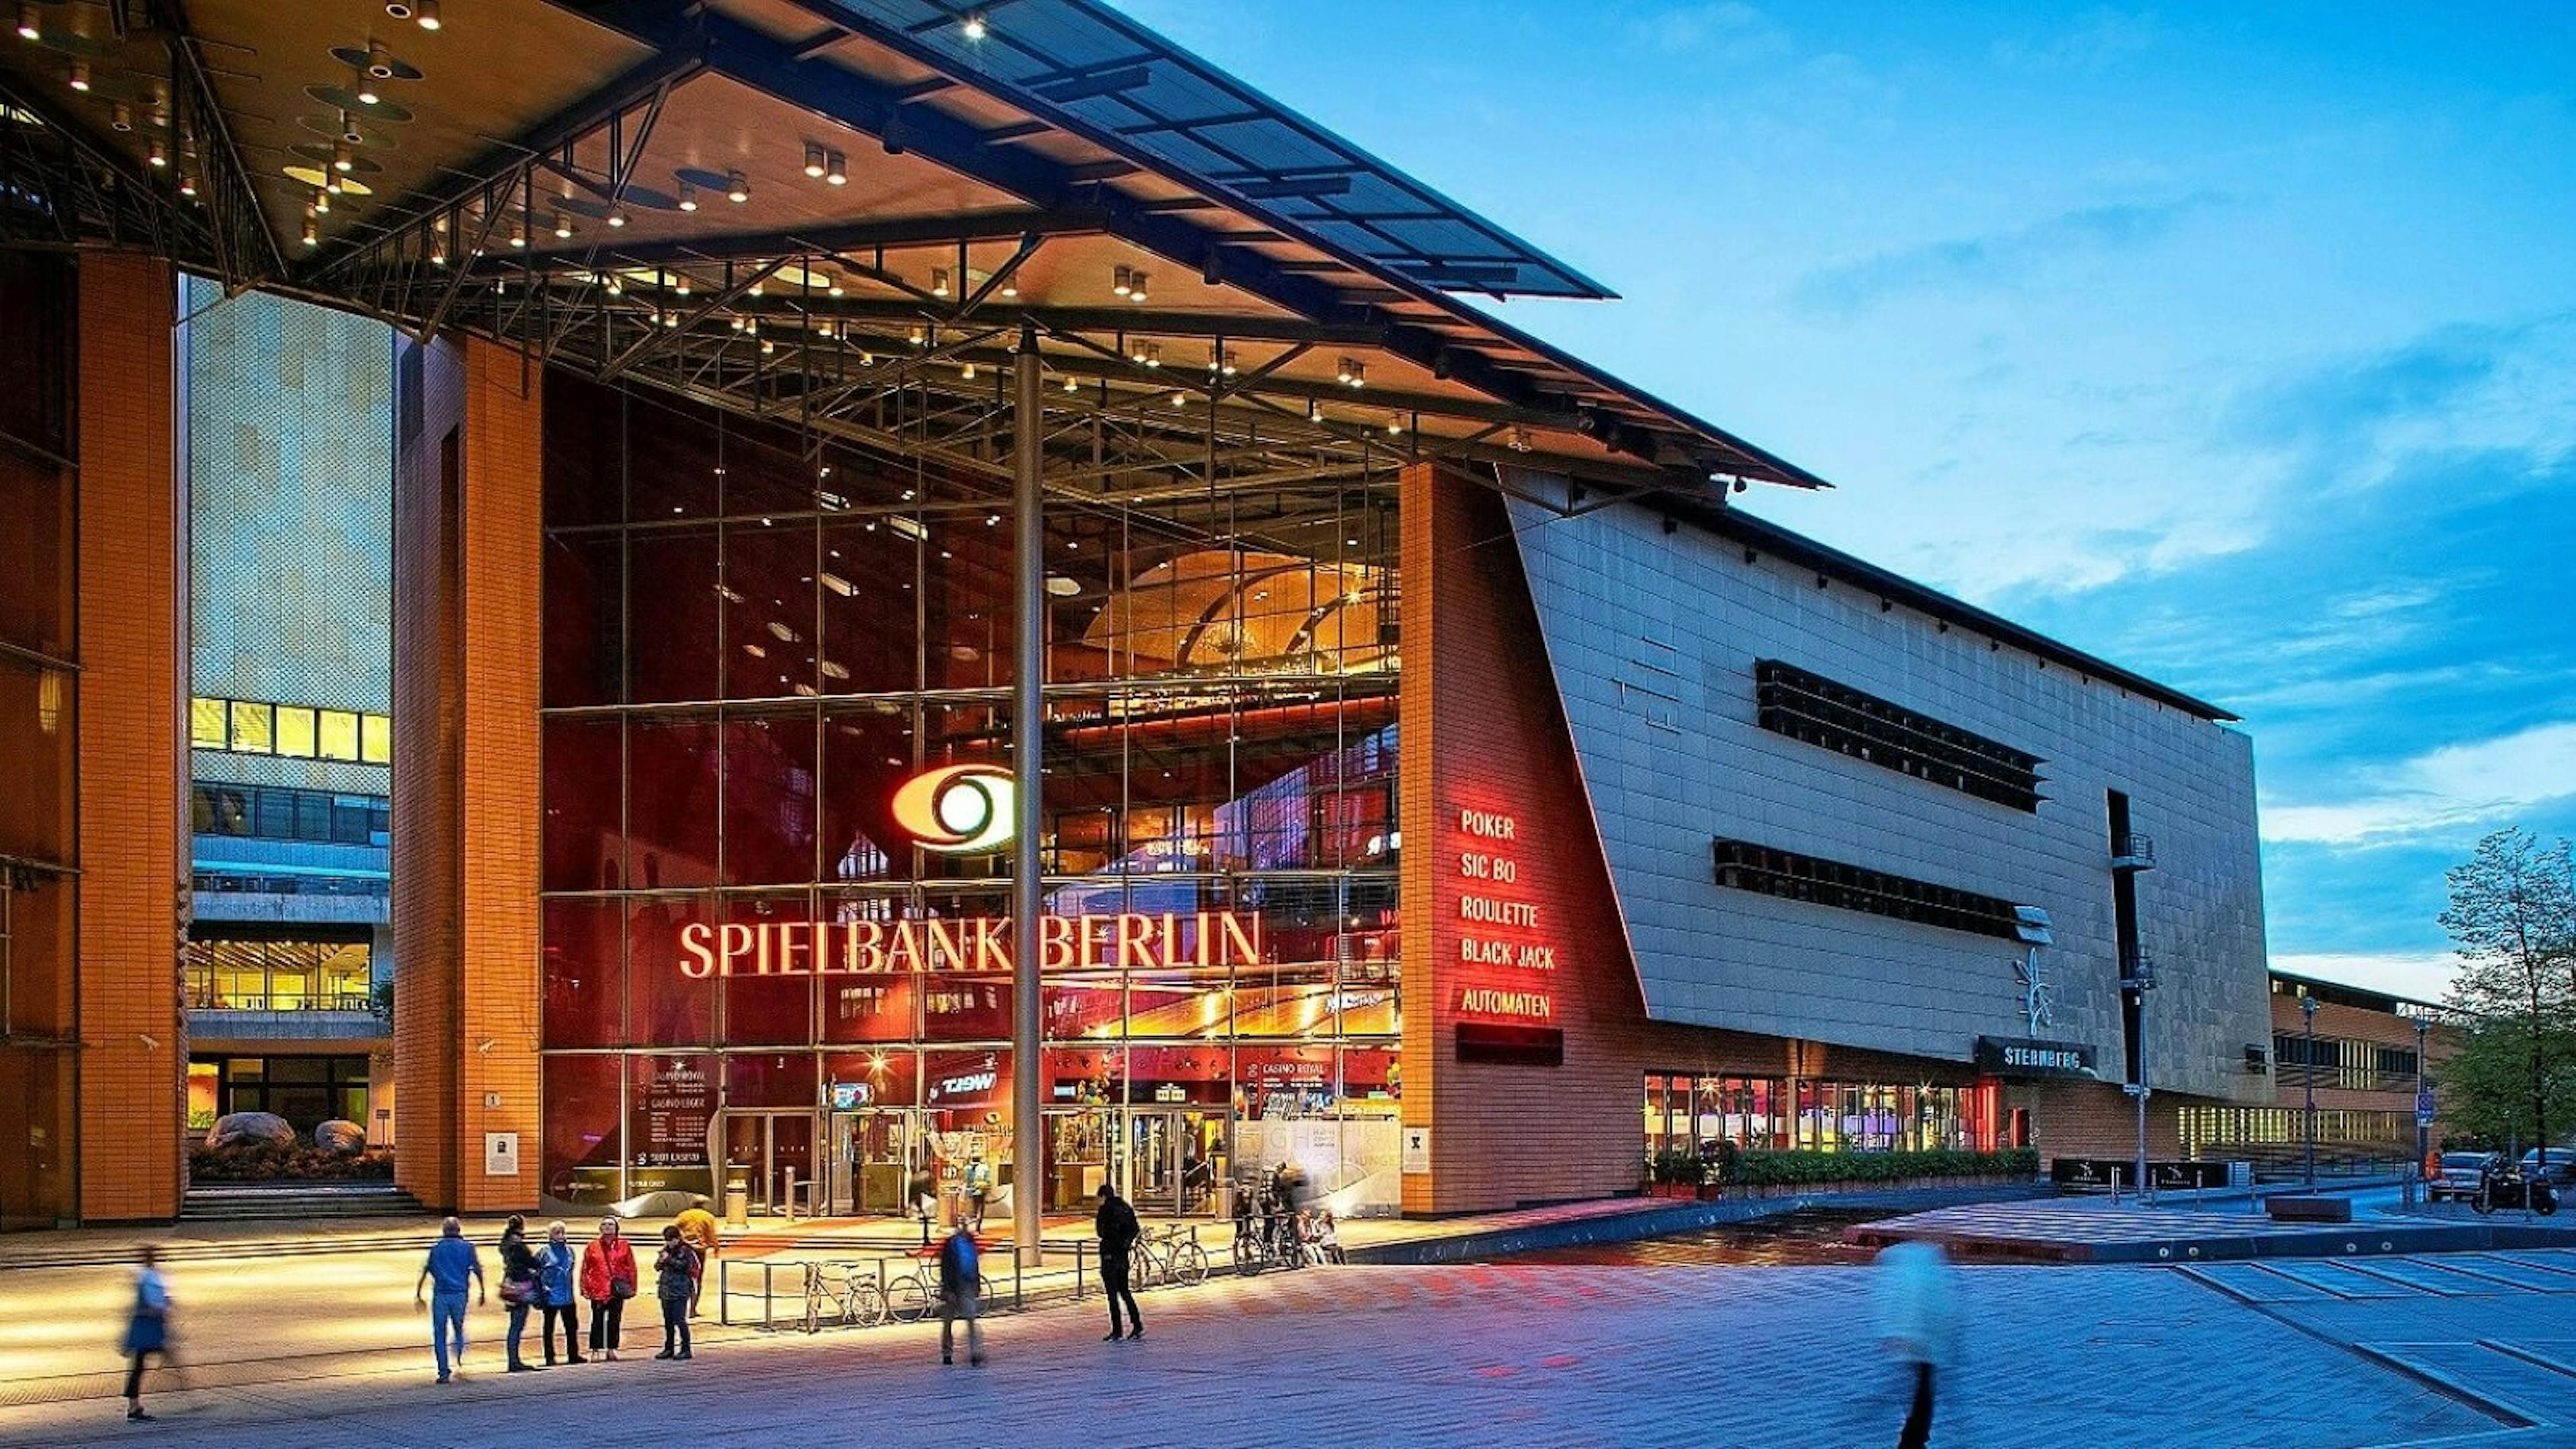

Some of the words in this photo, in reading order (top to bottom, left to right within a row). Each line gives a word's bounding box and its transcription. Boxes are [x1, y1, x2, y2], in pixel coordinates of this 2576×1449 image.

[1462, 809, 1515, 839] POKER
[1462, 852, 1488, 878] SIC
[1492, 857, 1516, 884] BO
[1461, 895, 1539, 927] ROULETTE
[679, 917, 1013, 978] SPIELBANK
[1039, 910, 1259, 970] BERLIN
[1462, 938, 1513, 965] BLACK
[1517, 945, 1555, 970] JACK
[1461, 988, 1550, 1018] AUTOMATEN
[491, 1094, 495, 1105] 1
